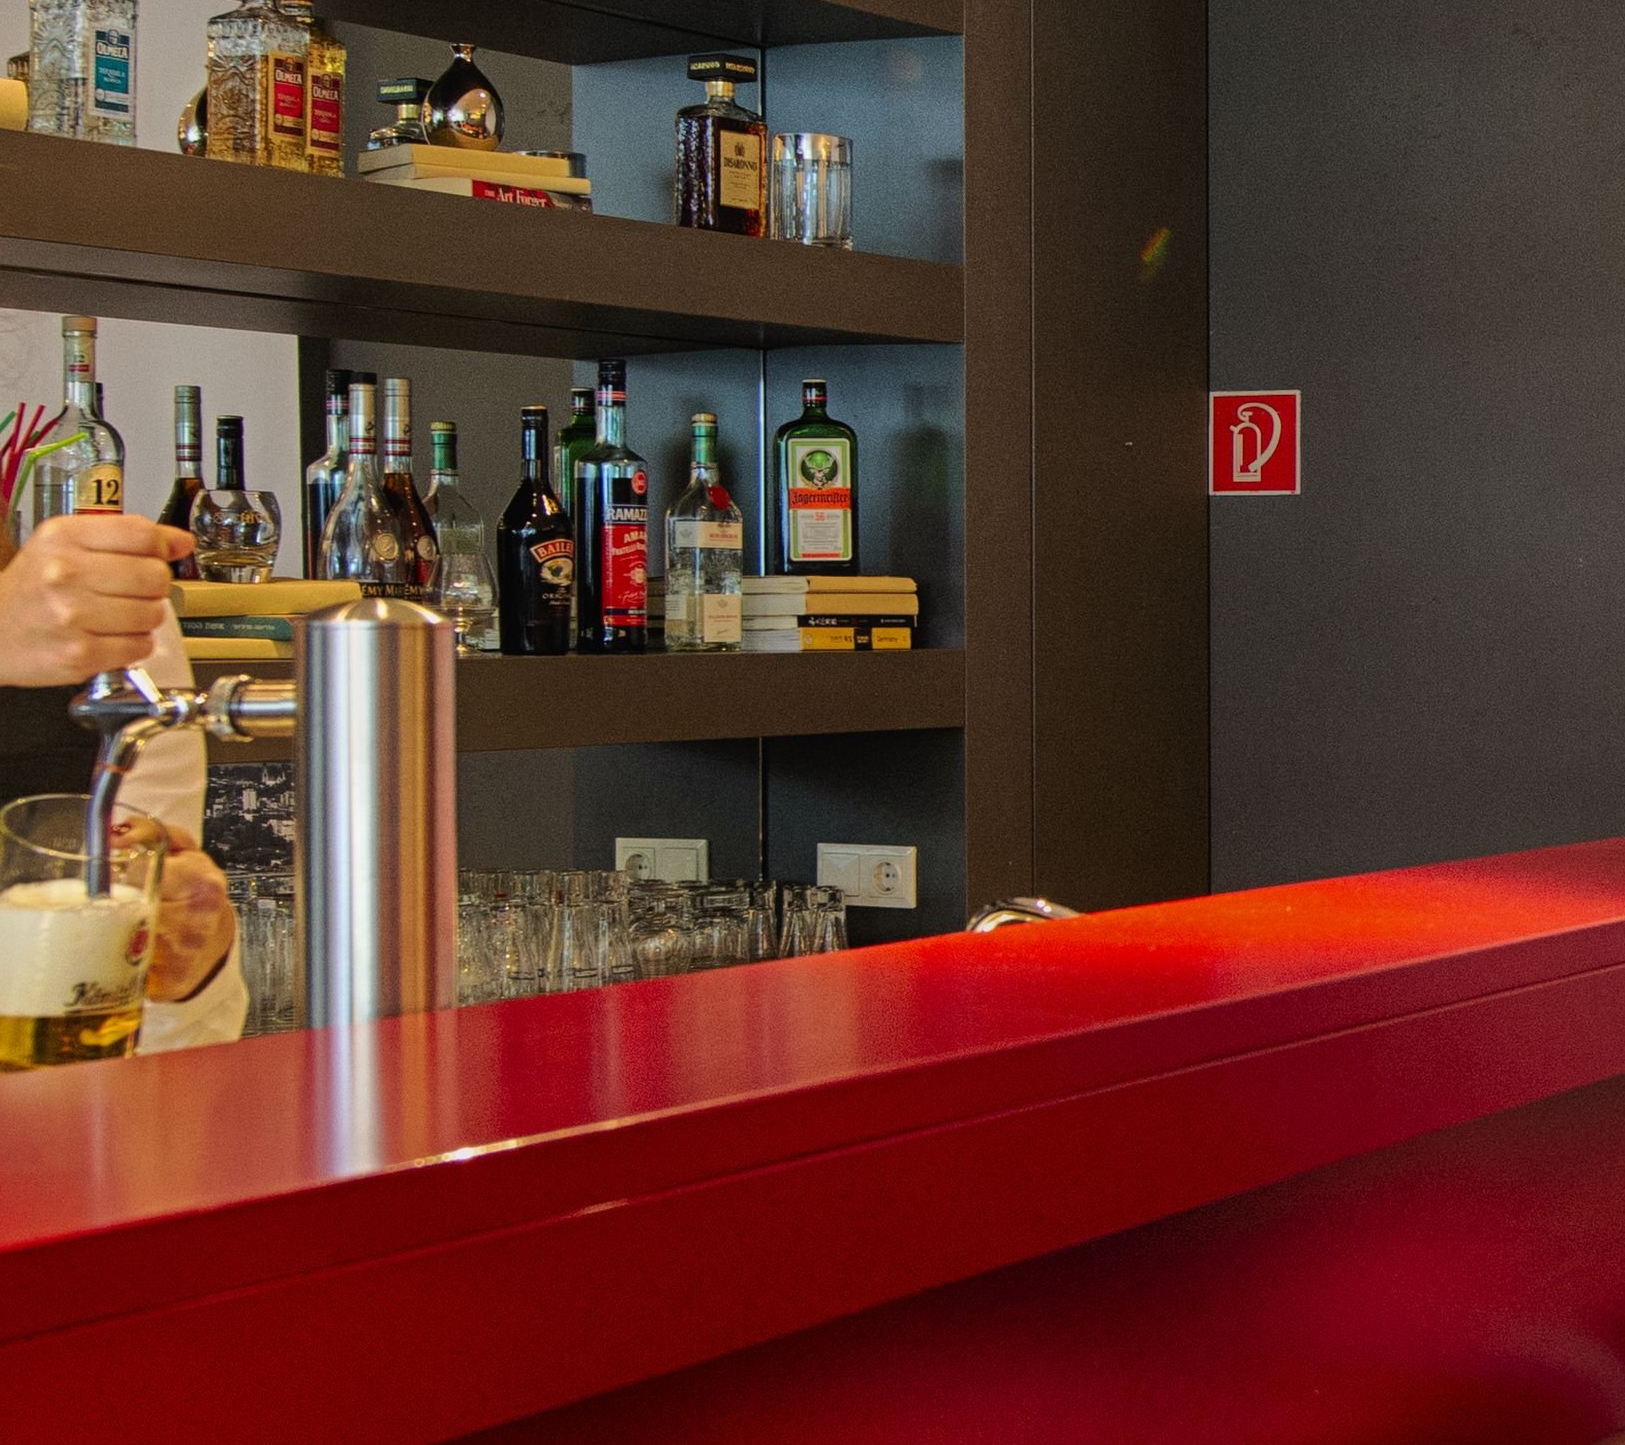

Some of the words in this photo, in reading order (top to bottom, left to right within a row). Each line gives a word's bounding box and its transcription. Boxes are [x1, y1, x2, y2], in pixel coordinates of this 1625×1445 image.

[96, 41, 129, 58] OLMECA
[275, 69, 303, 85] OLMECA
[313, 85, 340, 101] OLMECA
[724, 156, 758, 172] DISARONNO
[496, 187, 515, 203] Art
[516, 190, 548, 208] Forger
[93, 478, 120, 506] 12
[791, 490, 847, 505] Jägermeister
[607, 508, 647, 522] RAMAZZ
[537, 541, 574, 558] BAILE
[362, 583, 385, 597] ÉMY
